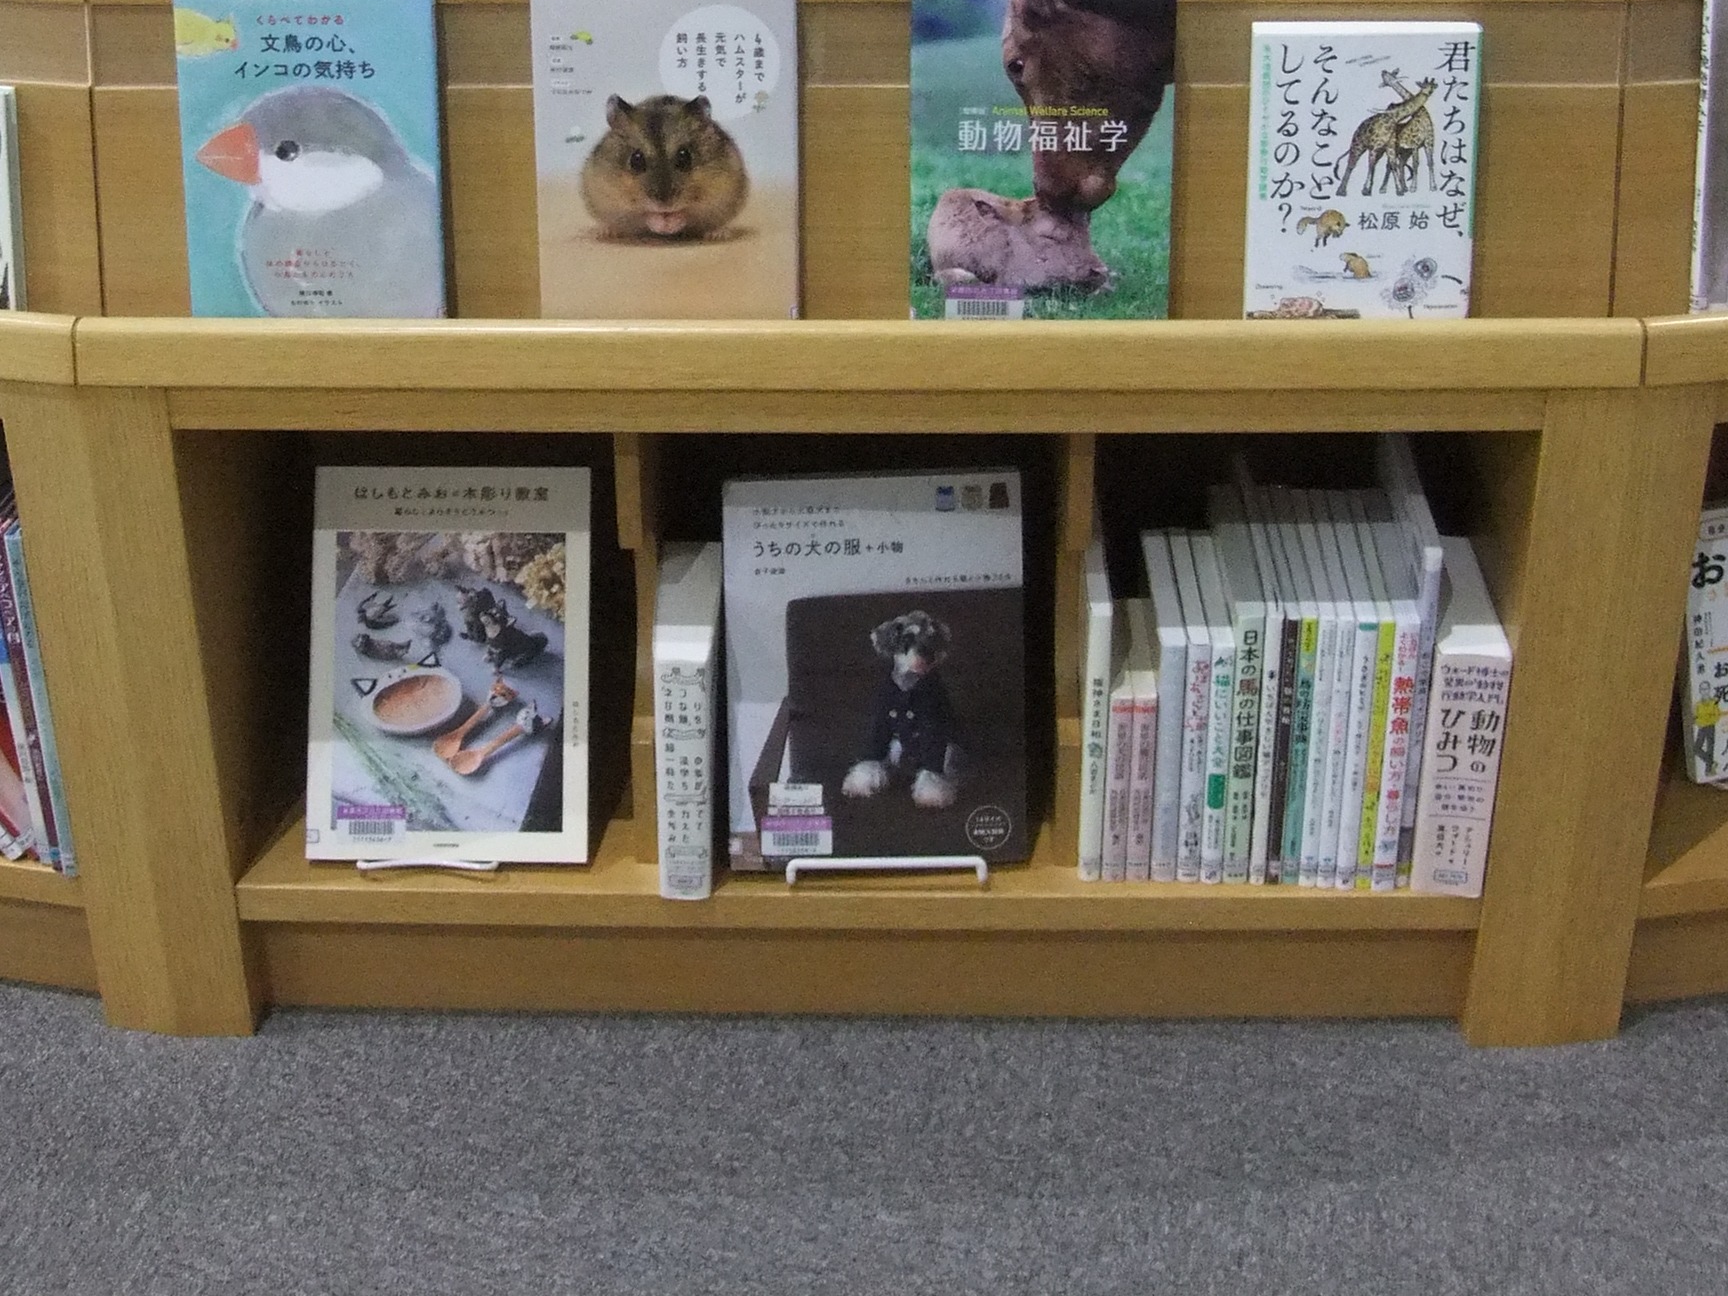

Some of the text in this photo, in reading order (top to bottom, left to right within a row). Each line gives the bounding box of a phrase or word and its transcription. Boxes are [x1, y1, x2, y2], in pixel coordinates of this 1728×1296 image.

[255, 14, 345, 26] くらべてわかる
[260, 33, 356, 54] 文鳥の心、
[676, 32, 688, 68] 飼い方
[715, 32, 727, 68] 元気で
[234, 61, 376, 79] インコの気持ち
[695, 32, 708, 93] 長生きする
[734, 33, 747, 104] ハムスターが
[992, 106, 1027, 117] Animal
[1029, 106, 1067, 117] Welfare
[1069, 106, 1109, 117] Science
[1310, 44, 1339, 200] そんなこと
[958, 120, 1128, 152] 動物福祉学
[1358, 211, 1400, 230] 松原
[1231, 630, 1259, 779] 日本の馬の仕事図鑑
[1437, 708, 1465, 772] ひみつ
[1467, 709, 1500, 773] 動物の
